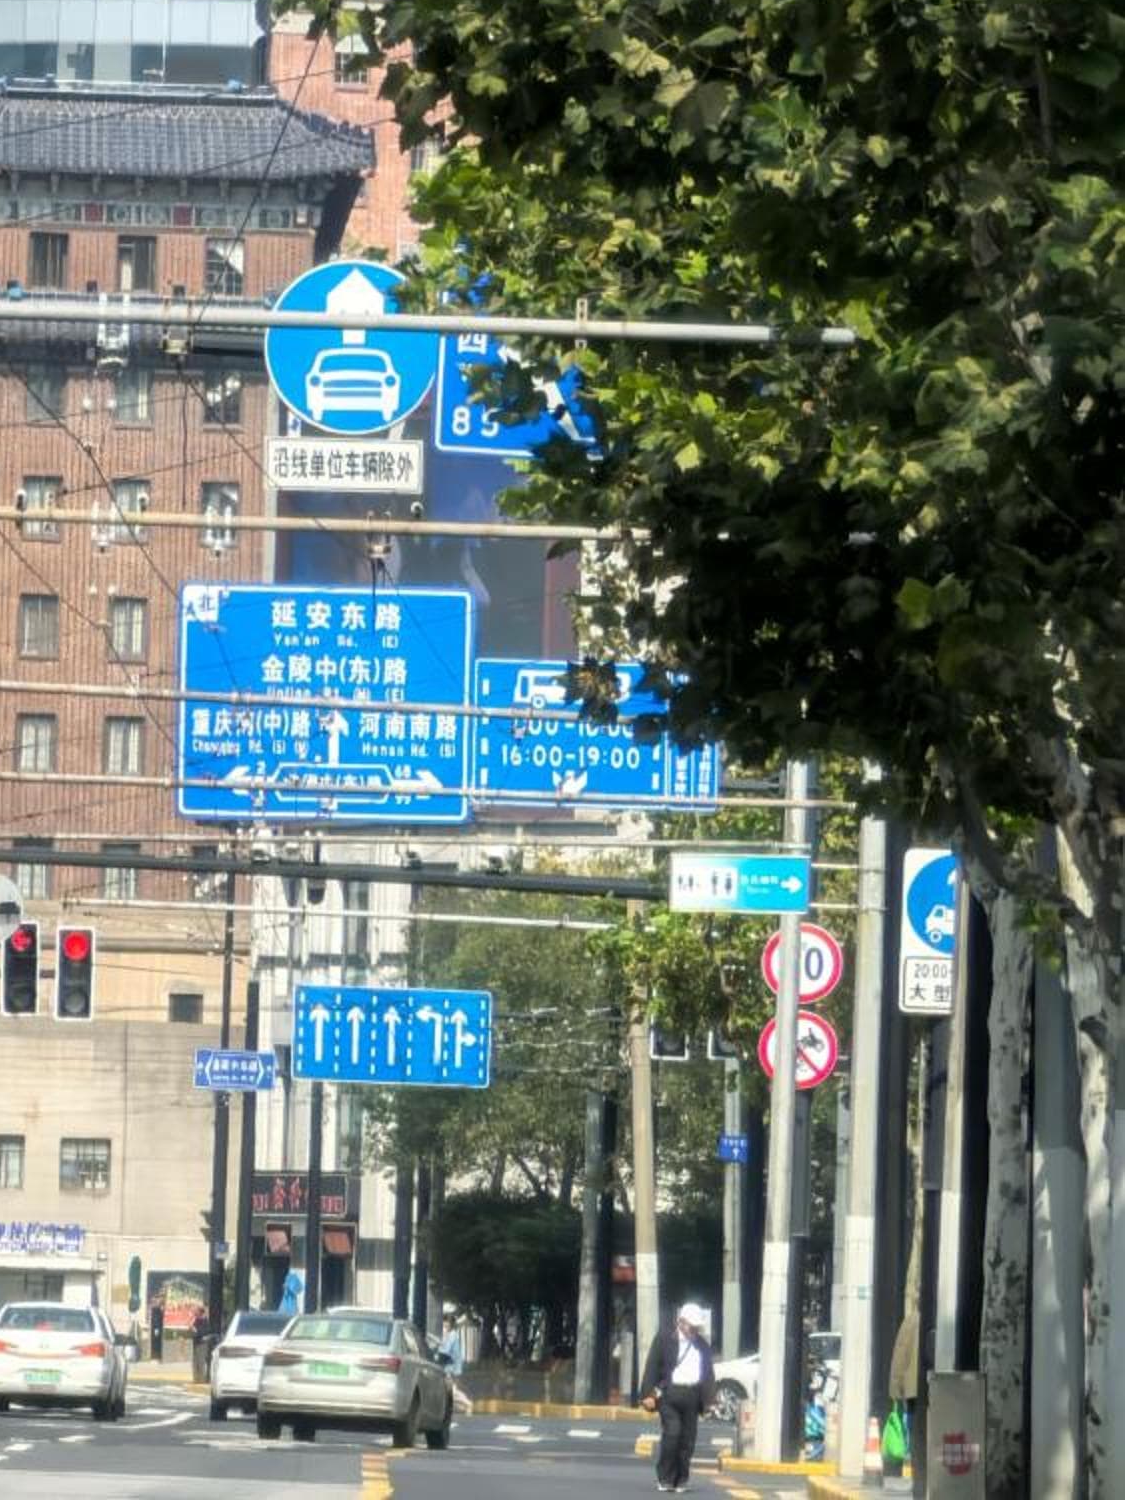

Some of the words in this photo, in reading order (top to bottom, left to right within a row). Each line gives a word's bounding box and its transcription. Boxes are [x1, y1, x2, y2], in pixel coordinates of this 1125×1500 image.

[274, 447, 414, 483] 沿线单位车辆除外
[271, 600, 402, 631] 延安东路
[261, 653, 408, 685] 金陵中(东)路
[359, 711, 457, 741] 河南南路
[502, 744, 641, 769] 16:00-19:00
